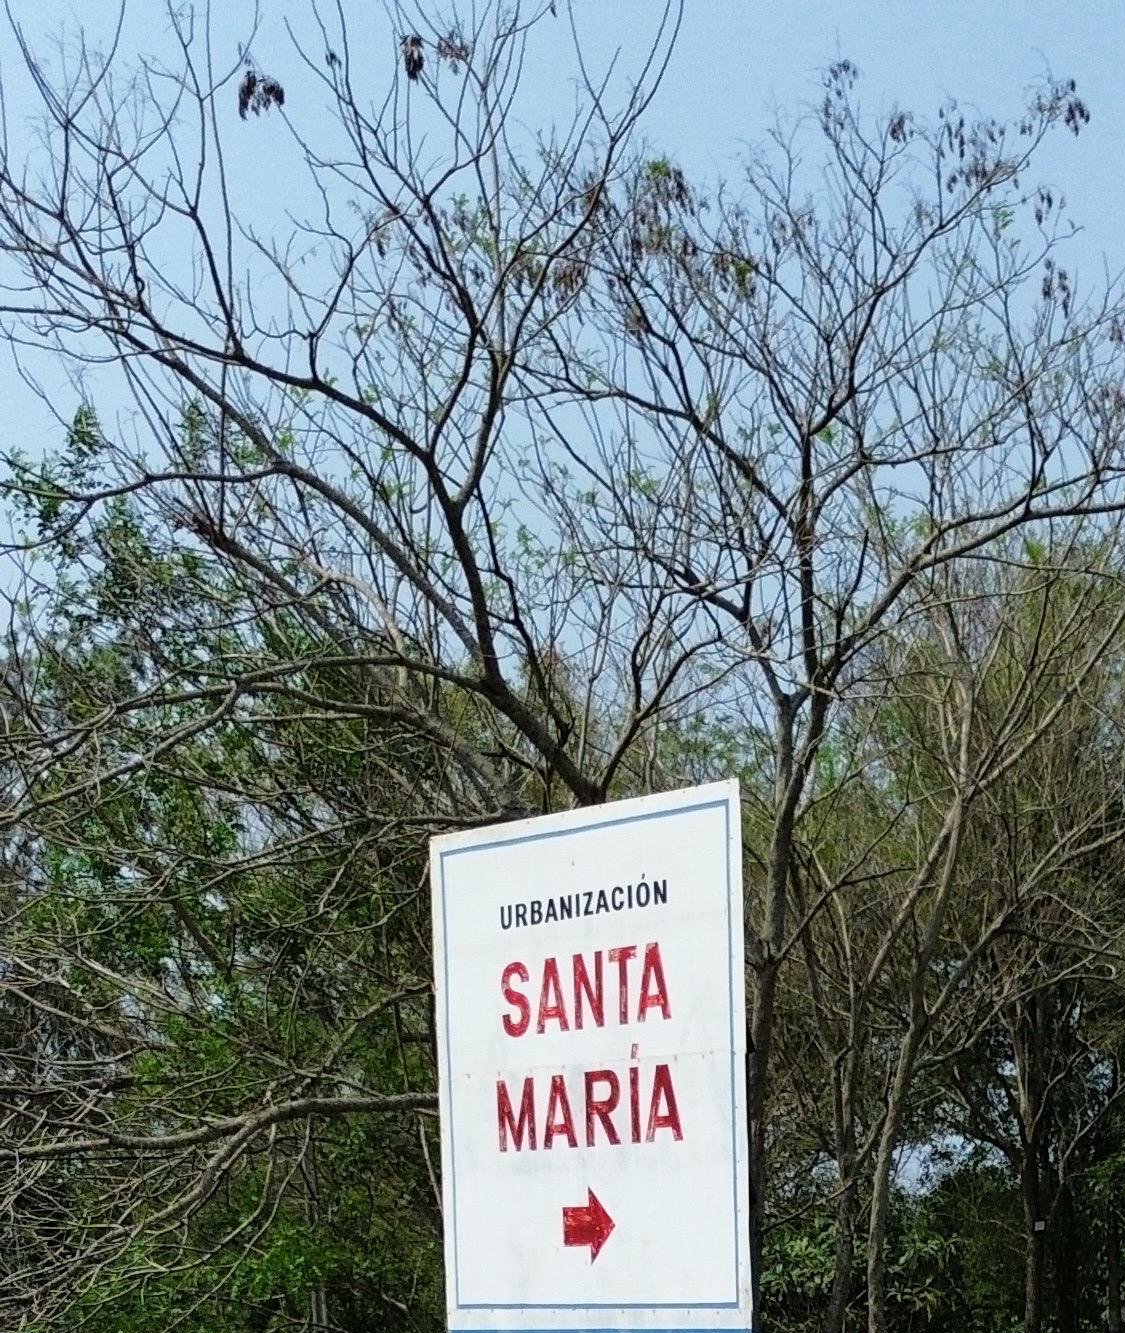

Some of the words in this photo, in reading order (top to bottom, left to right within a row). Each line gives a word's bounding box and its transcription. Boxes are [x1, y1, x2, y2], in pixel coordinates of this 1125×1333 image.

[500, 873, 668, 930] URBANIZACIÓN
[500, 942, 672, 1038] SANTA
[496, 1043, 684, 1153] MARÍA
